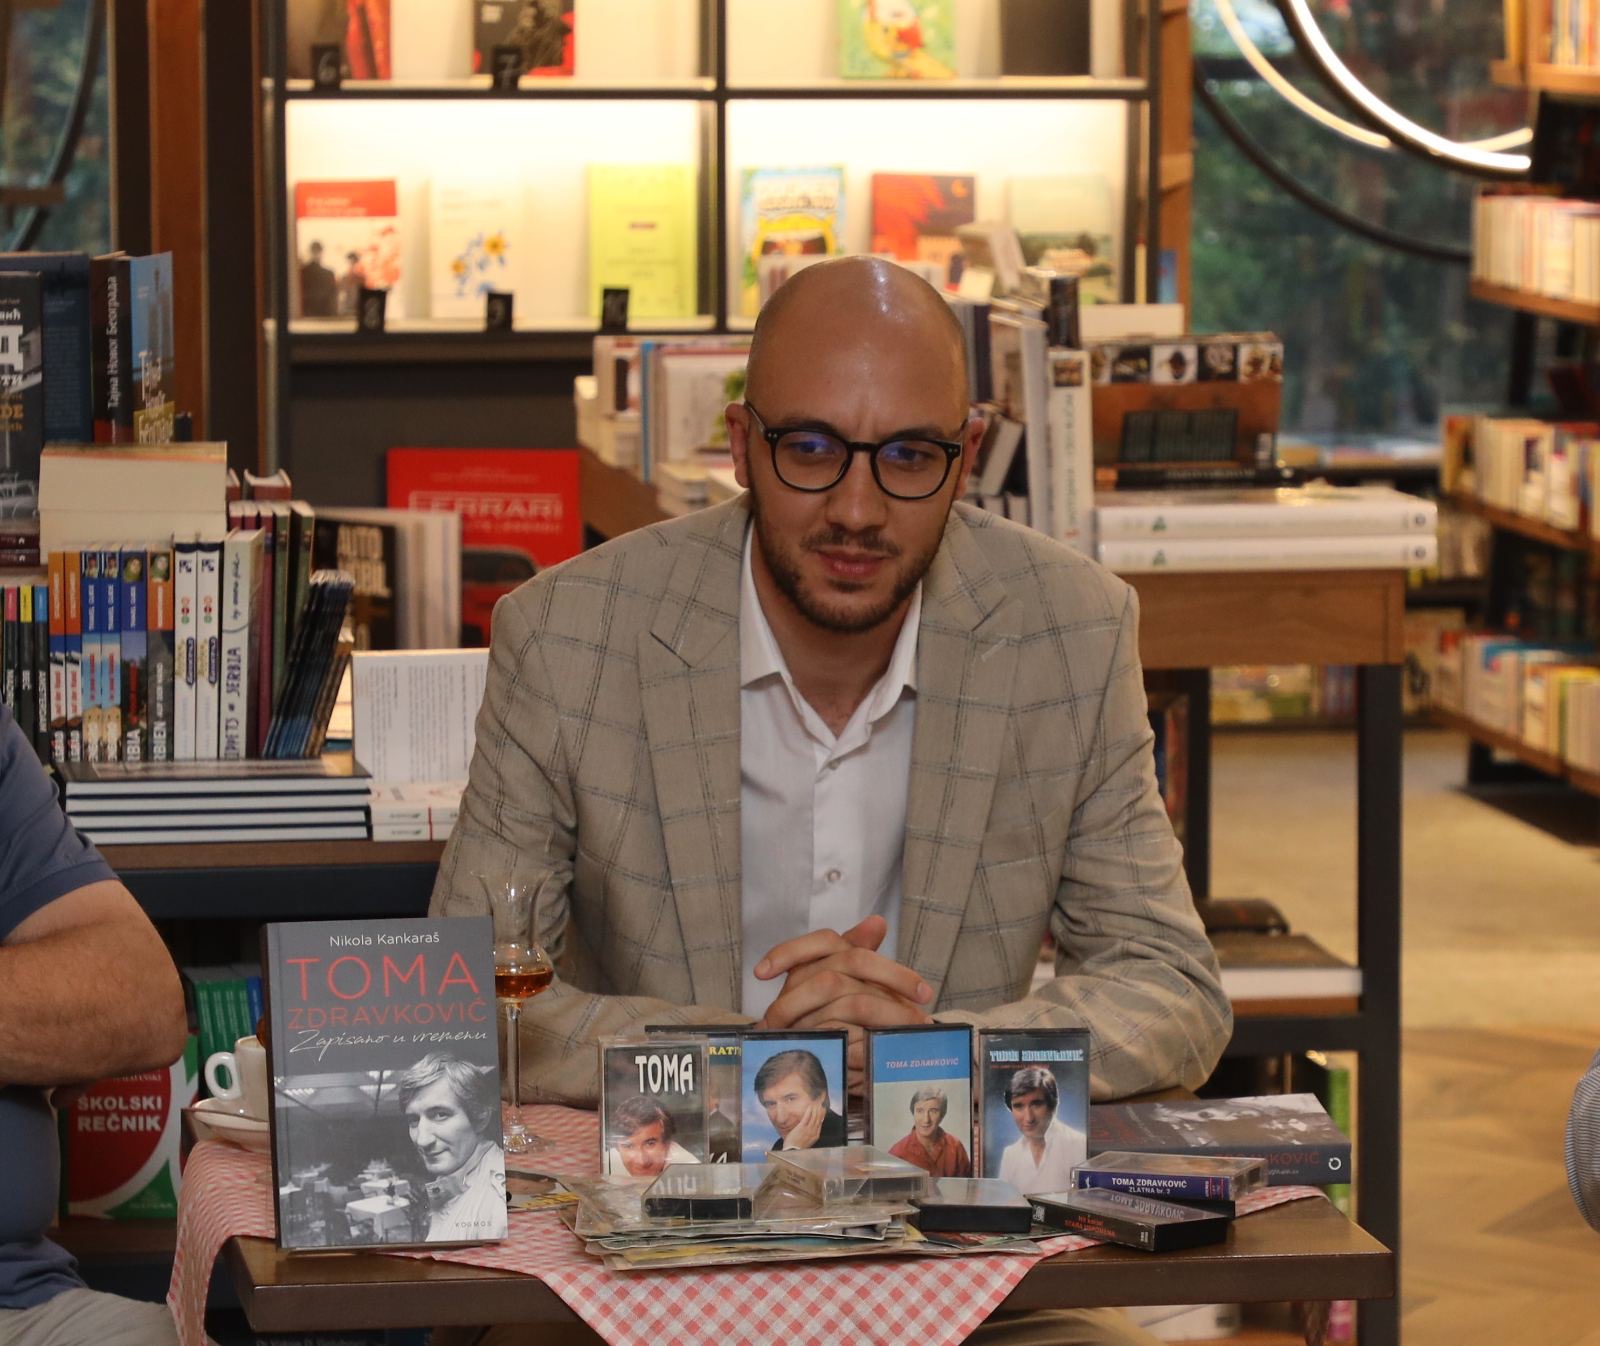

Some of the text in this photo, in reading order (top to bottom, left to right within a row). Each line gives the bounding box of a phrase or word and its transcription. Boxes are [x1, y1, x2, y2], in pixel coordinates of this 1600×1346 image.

[226, 647, 242, 698] SERBIA
[329, 931, 440, 948] Nikola Kankaraš
[286, 951, 480, 1001] TOMA
[287, 997, 487, 1030] ZDRAVKOVIĆ
[290, 1028, 488, 1061] Zapisano u vremenu
[634, 1053, 693, 1094] TOMA
[886, 1060, 909, 1070] TOMA
[78, 1094, 162, 1111] ŠKOLSKI
[78, 1112, 162, 1132] REČNIK
[1112, 1177, 1135, 1186] TOMA
